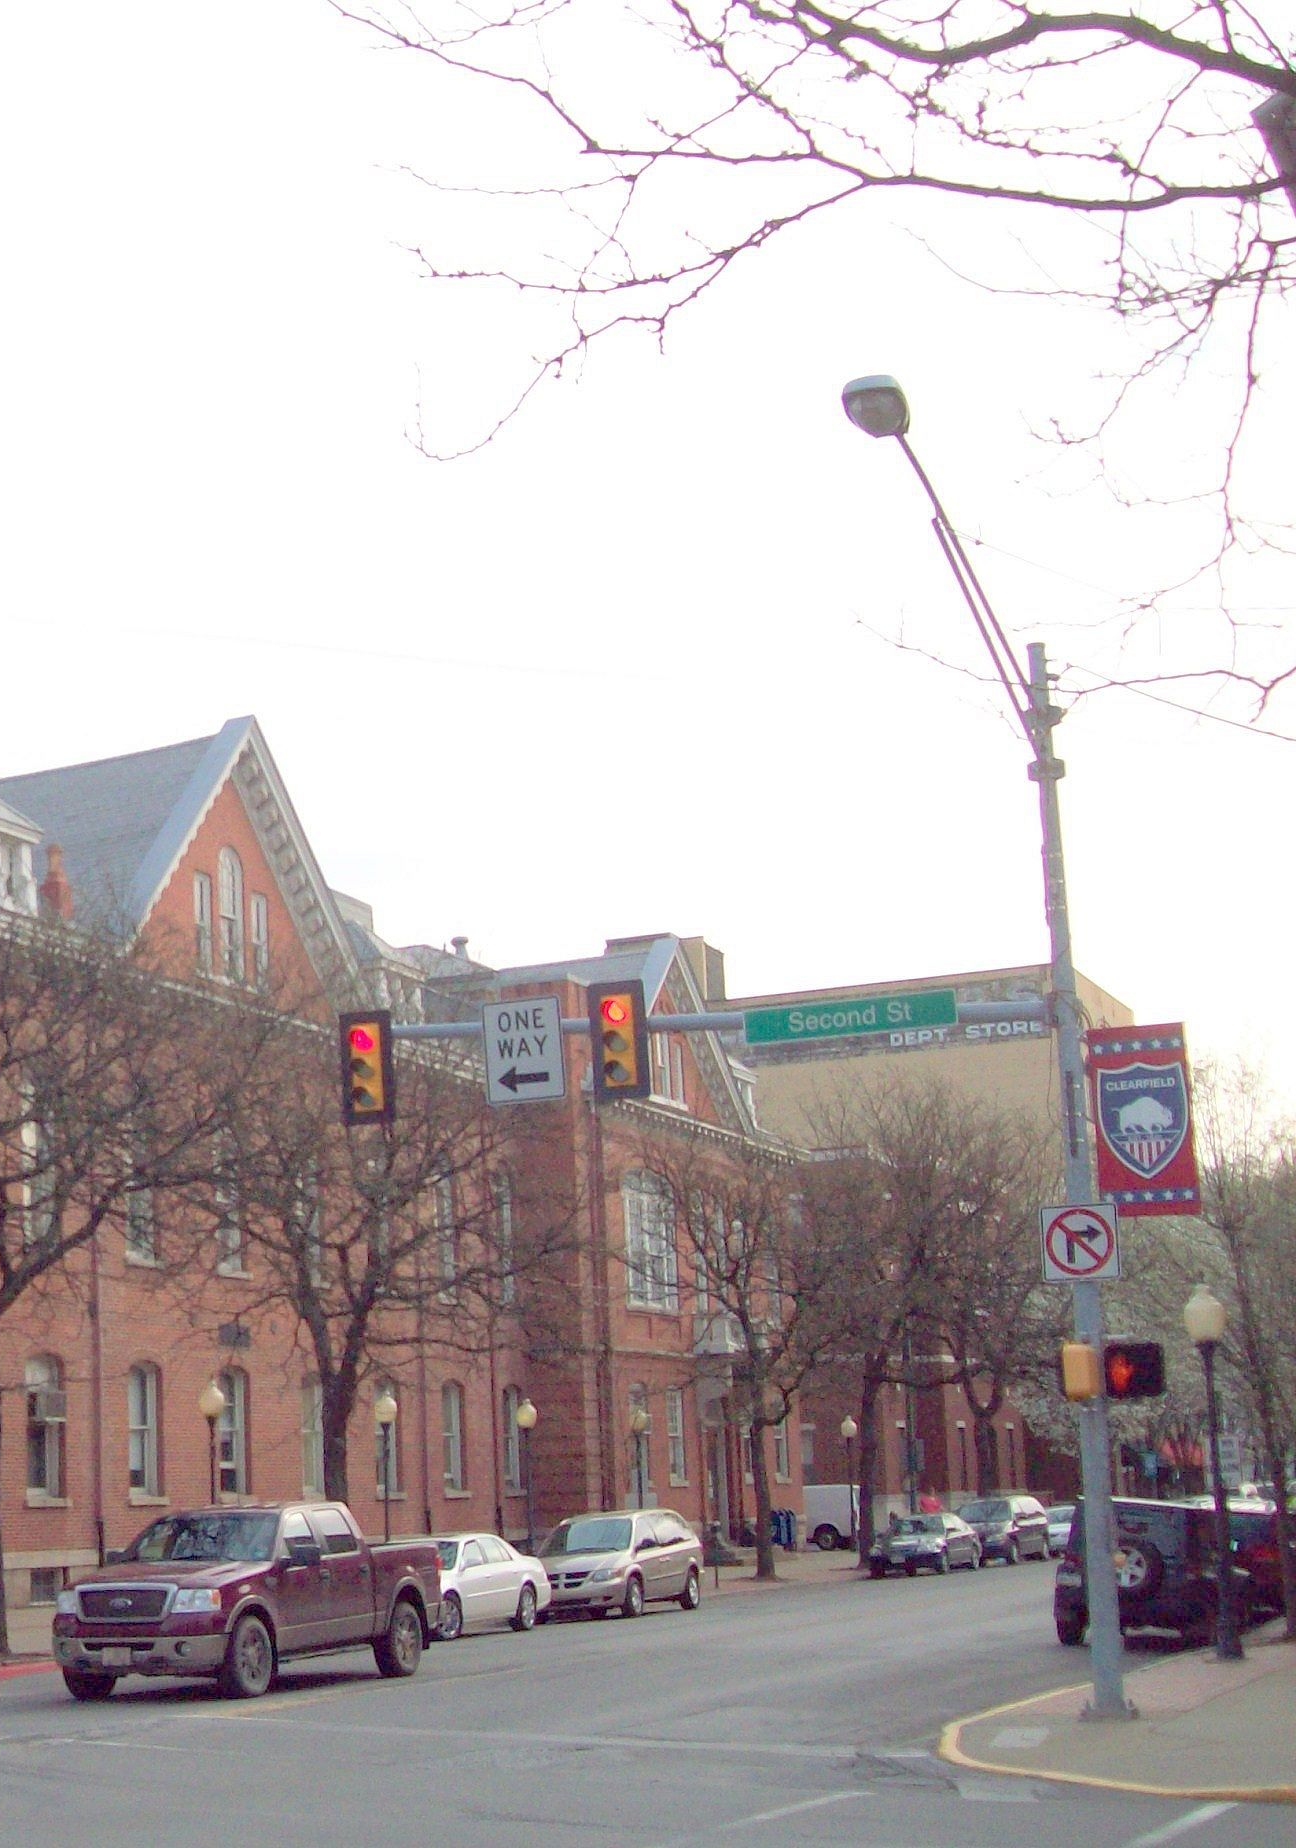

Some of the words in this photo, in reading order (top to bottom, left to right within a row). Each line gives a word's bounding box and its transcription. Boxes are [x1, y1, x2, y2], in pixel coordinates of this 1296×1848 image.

[498, 1007, 545, 1032] ONE
[788, 1004, 876, 1033] Second
[887, 1000, 912, 1023] St
[890, 1028, 951, 1047] DEPT.
[965, 1020, 1044, 1039] STORE
[497, 1035, 547, 1058] WAY
[1106, 1077, 1176, 1091] CLEARFIELD
